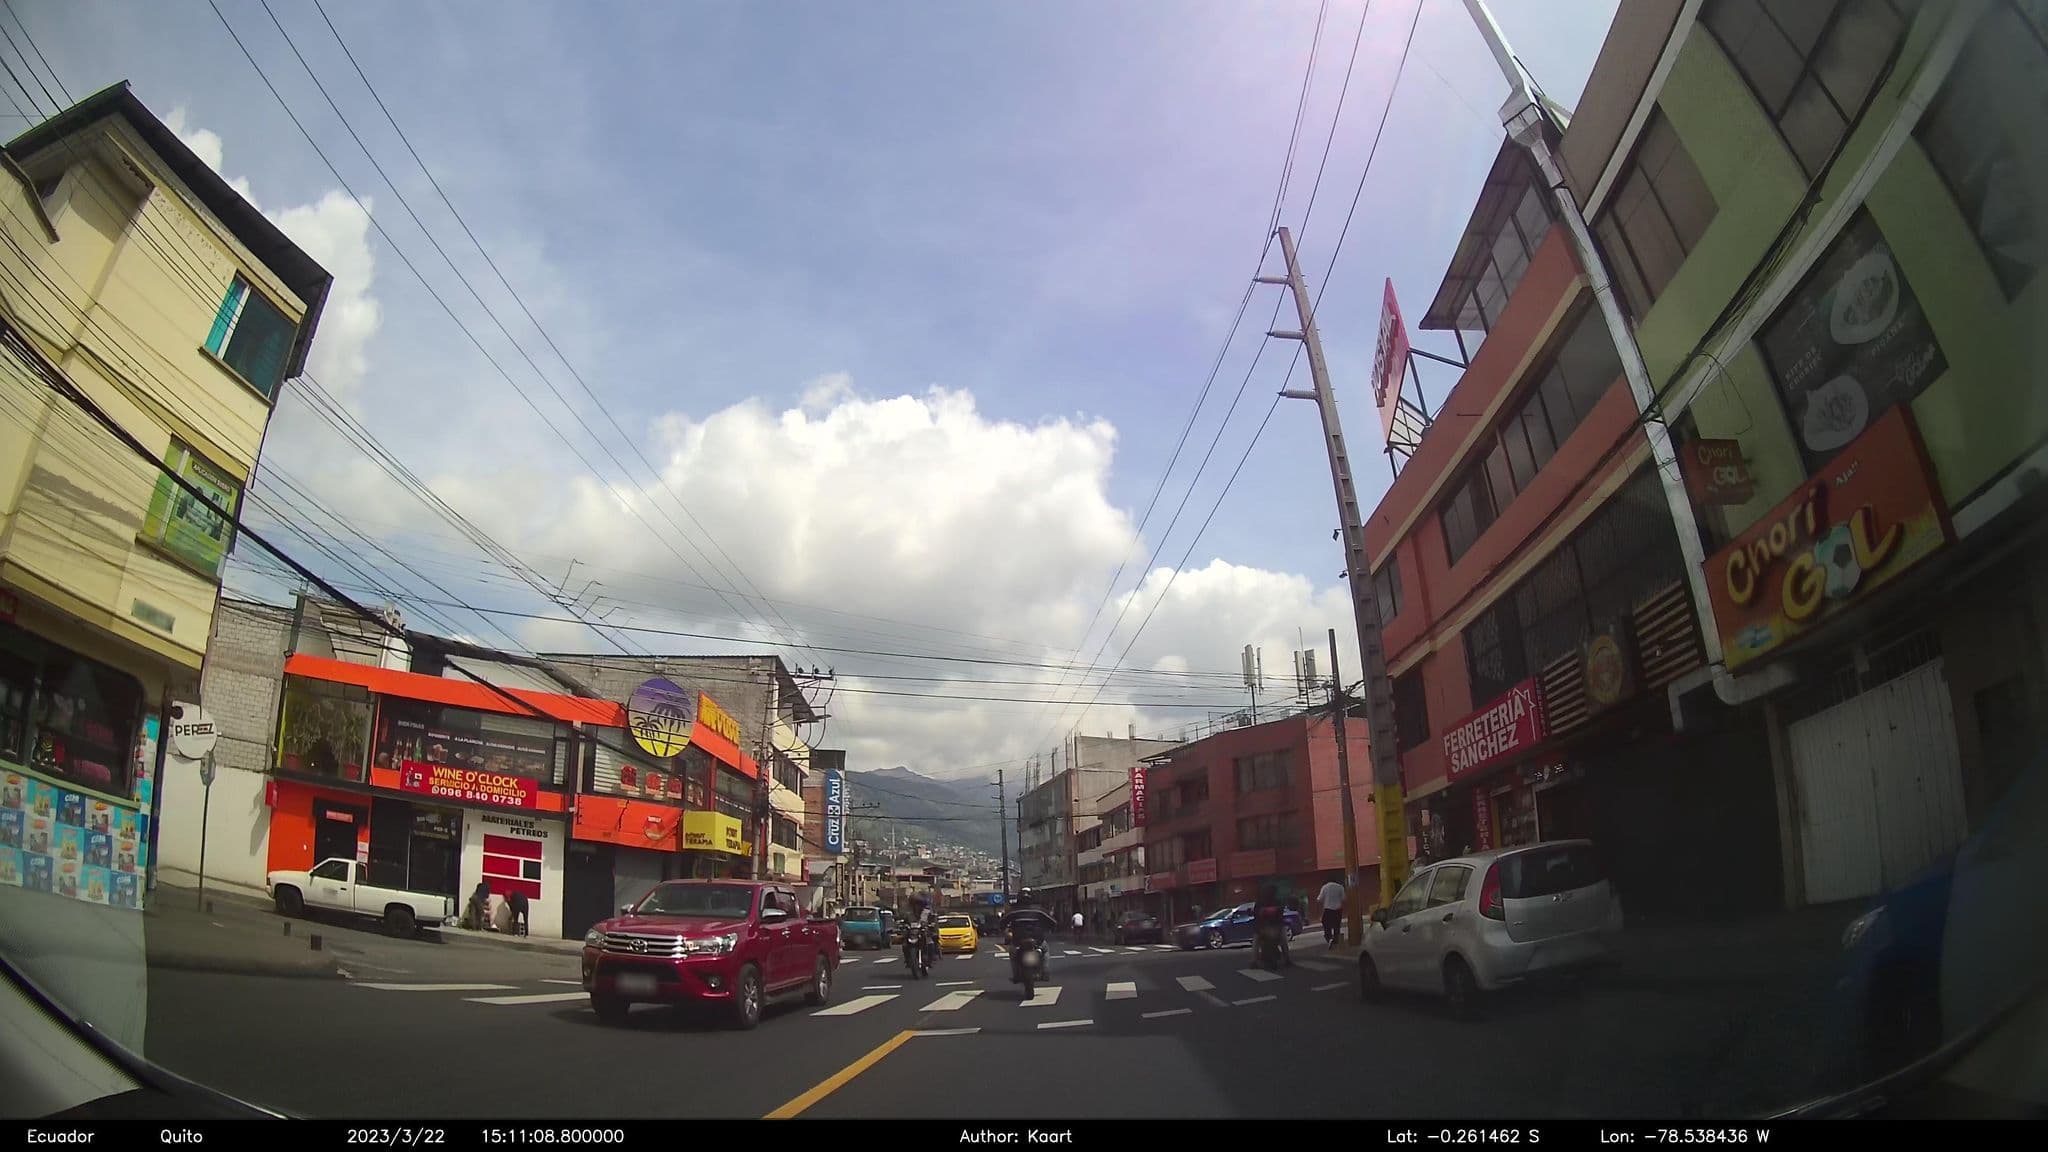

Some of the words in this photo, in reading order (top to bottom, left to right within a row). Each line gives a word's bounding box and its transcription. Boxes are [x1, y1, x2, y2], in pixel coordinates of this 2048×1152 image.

[1697, 445, 1735, 464] Chori
[1726, 486, 1816, 605] Chori
[1450, 722, 1520, 774] SANCHEZ
[428, 777, 470, 790] SERVICIO
[480, 784, 527, 798] DOMICILIO
[432, 765, 464, 781] WINE
[465, 771, 519, 789] O'CLOCK
[440, 786, 462, 798] 096
[492, 794, 522, 806] 0738
[829, 778, 841, 803] Azul
[481, 815, 535, 829] MATERIALES
[828, 818, 839, 845] Cruz
